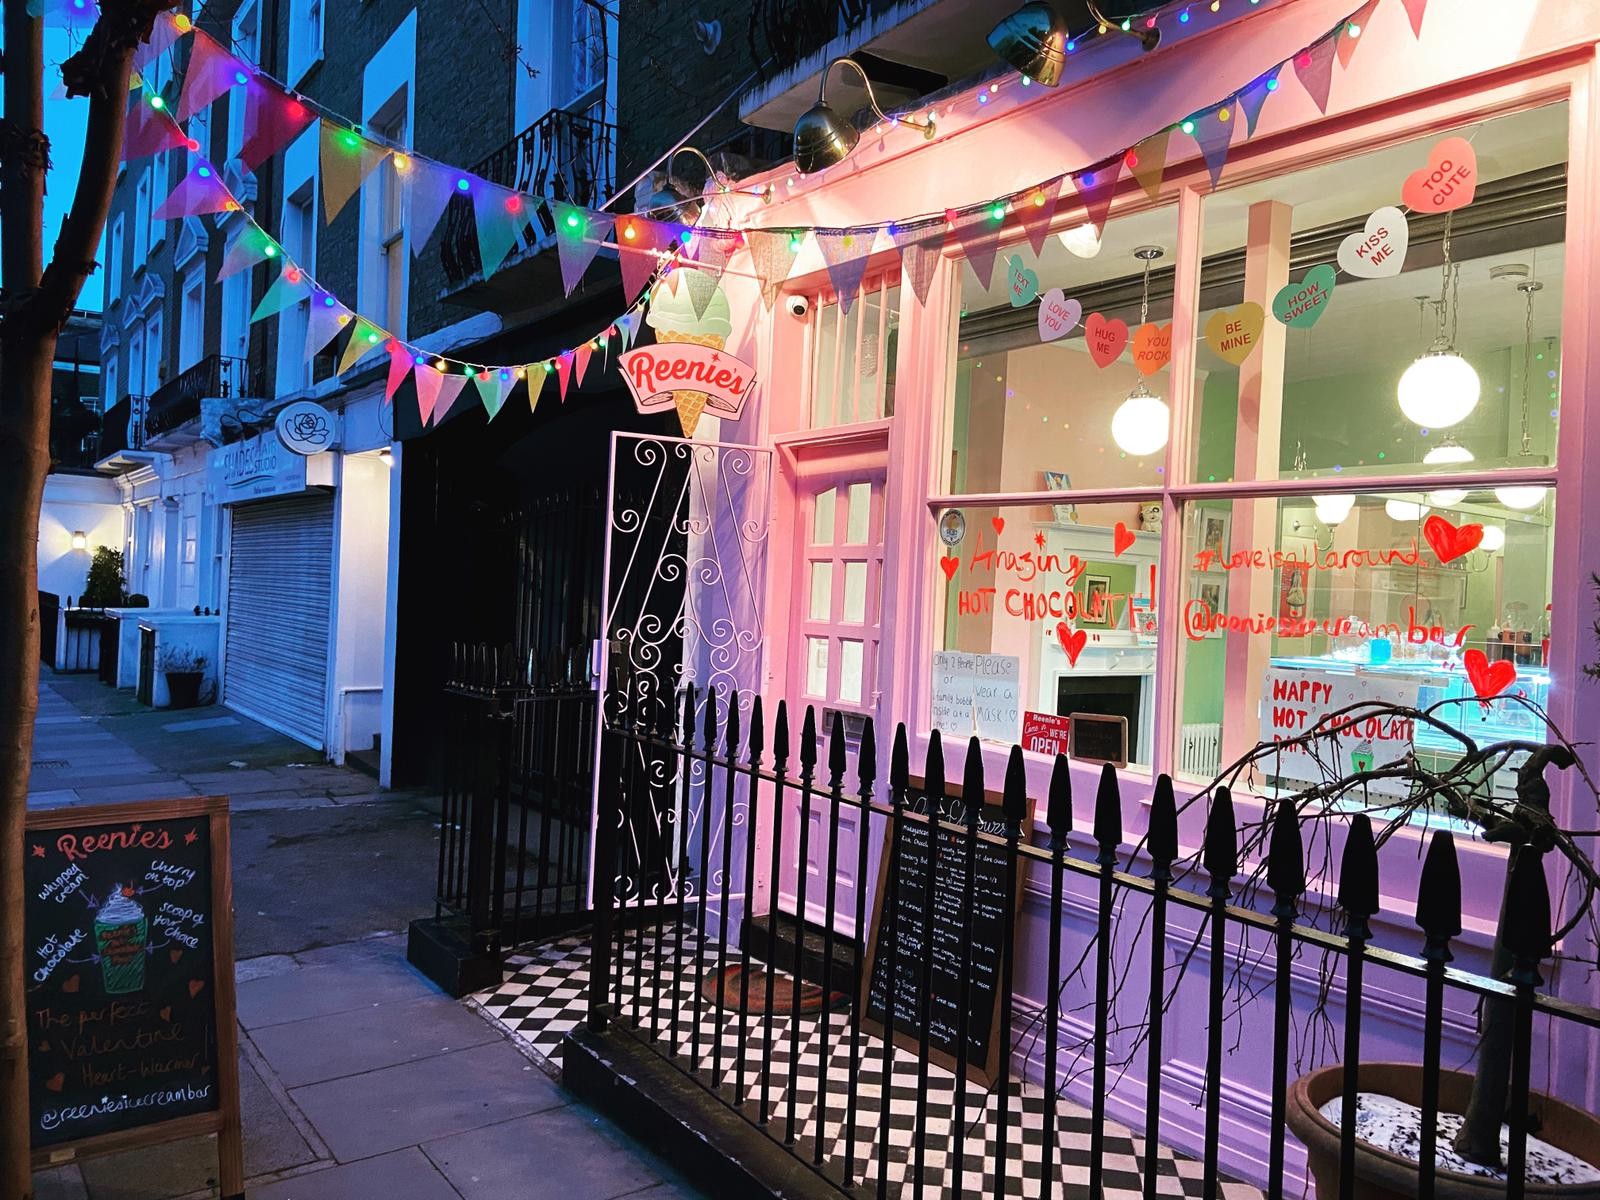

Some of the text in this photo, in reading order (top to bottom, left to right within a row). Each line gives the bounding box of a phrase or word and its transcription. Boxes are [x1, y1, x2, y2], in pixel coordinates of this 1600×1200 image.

[1421, 159, 1454, 191] TOO
[1432, 165, 1472, 206] CUTE
[1355, 227, 1389, 259] KISS
[1370, 243, 1395, 266] ME
[1014, 269, 1030, 288] TEXT
[1012, 284, 1023, 297] ME
[1287, 281, 1320, 308] HOW
[1048, 302, 1070, 321] LOVE
[1284, 289, 1330, 324] SWEET
[1044, 315, 1062, 331] YOU
[1225, 320, 1243, 335] BE
[1095, 327, 1115, 342] HUG
[1146, 336, 1170, 347] YOU
[1220, 333, 1252, 352] MINE
[1096, 342, 1110, 355] ME
[1137, 351, 1169, 361] ROCK
[628, 352, 745, 395] Reenie's
[970, 529, 1087, 586] Amazing
[958, 588, 996, 616] HOT
[975, 655, 1012, 675] Please
[944, 676, 953, 684] or
[1003, 689, 1013, 699] a
[1273, 678, 1333, 705] HAPPY
[1025, 722, 1039, 734] Come
[1033, 714, 1061, 725] Reenie's
[1273, 706, 1308, 730] HOT
[1049, 728, 1067, 740] WE'RE
[1030, 736, 1060, 756] OPEN
[57, 824, 173, 861] Reenie's
[38, 863, 82, 901] whipped
[144, 872, 185, 891] on top
[37, 934, 58, 959] Hot
[35, 1001, 151, 1034] The perfect
[60, 1023, 184, 1060] Valentine
